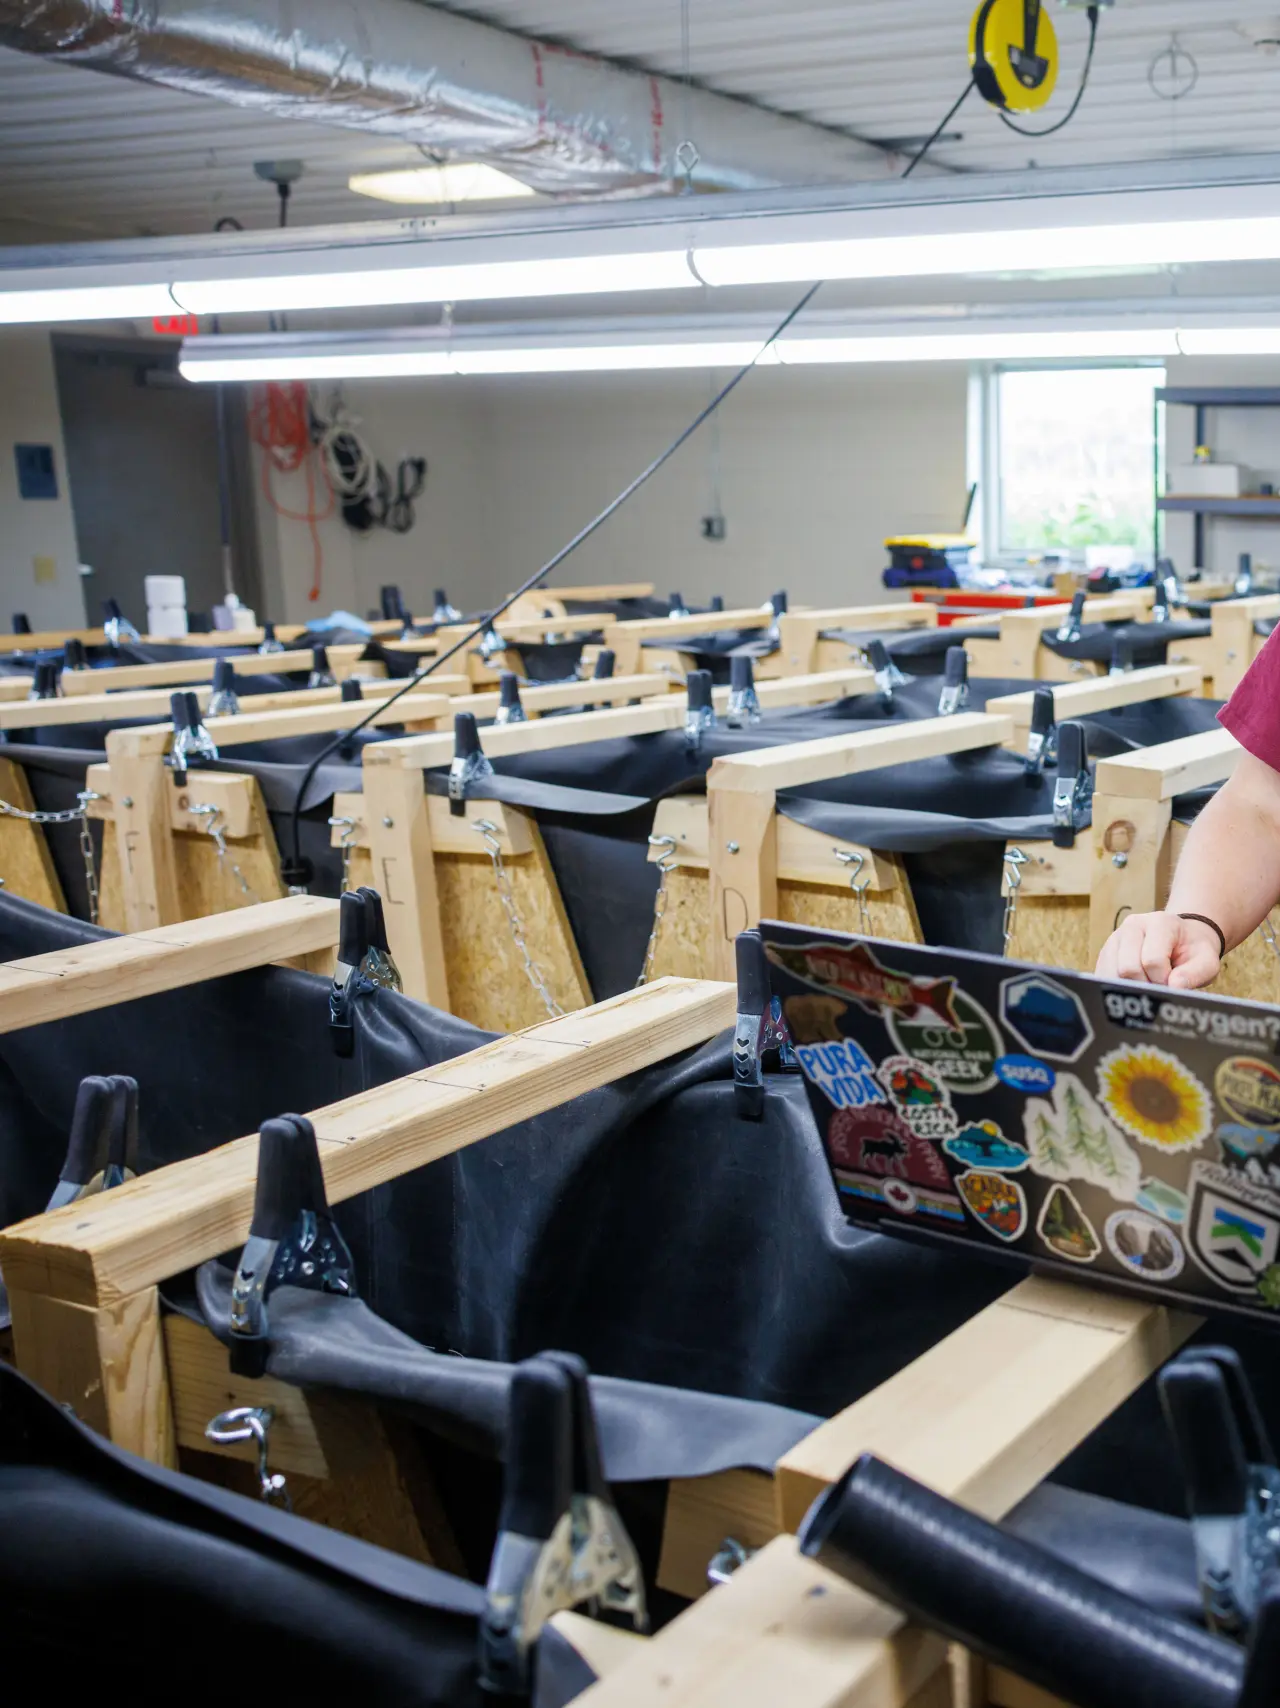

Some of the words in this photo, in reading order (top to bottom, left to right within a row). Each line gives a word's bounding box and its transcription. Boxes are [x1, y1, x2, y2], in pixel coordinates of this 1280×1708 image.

[1104, 993, 1156, 1019] got
[800, 1042, 873, 1079] PURA
[934, 1059, 986, 1079] GEEK
[819, 1074, 886, 1107] VIDA
